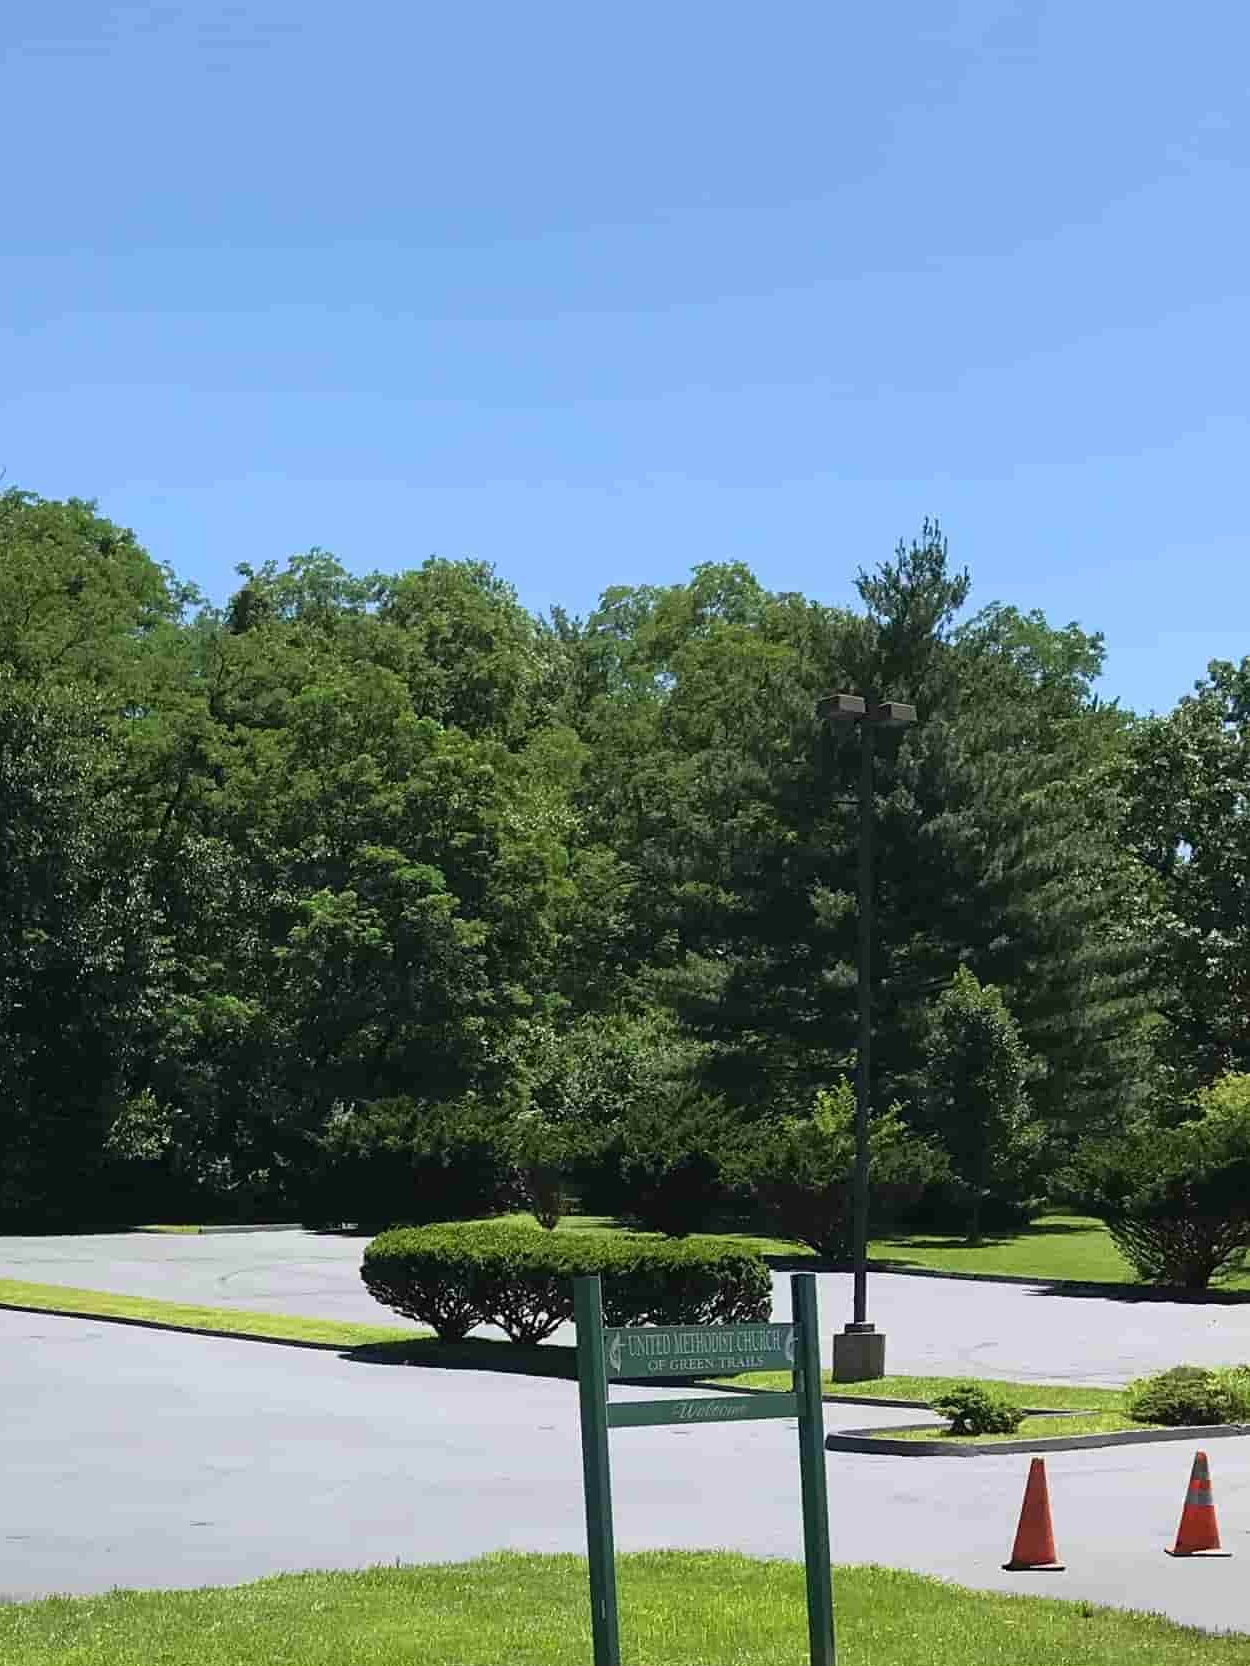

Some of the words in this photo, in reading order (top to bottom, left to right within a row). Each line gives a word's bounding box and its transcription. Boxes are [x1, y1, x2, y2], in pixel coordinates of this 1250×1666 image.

[628, 1333, 671, 1356] UNITED
[674, 1331, 734, 1354] METHODIST
[735, 1328, 782, 1353] CHURCH
[649, 1359, 663, 1370] OF
[669, 1358, 714, 1370] GREEN
[719, 1356, 765, 1369] TRAILS
